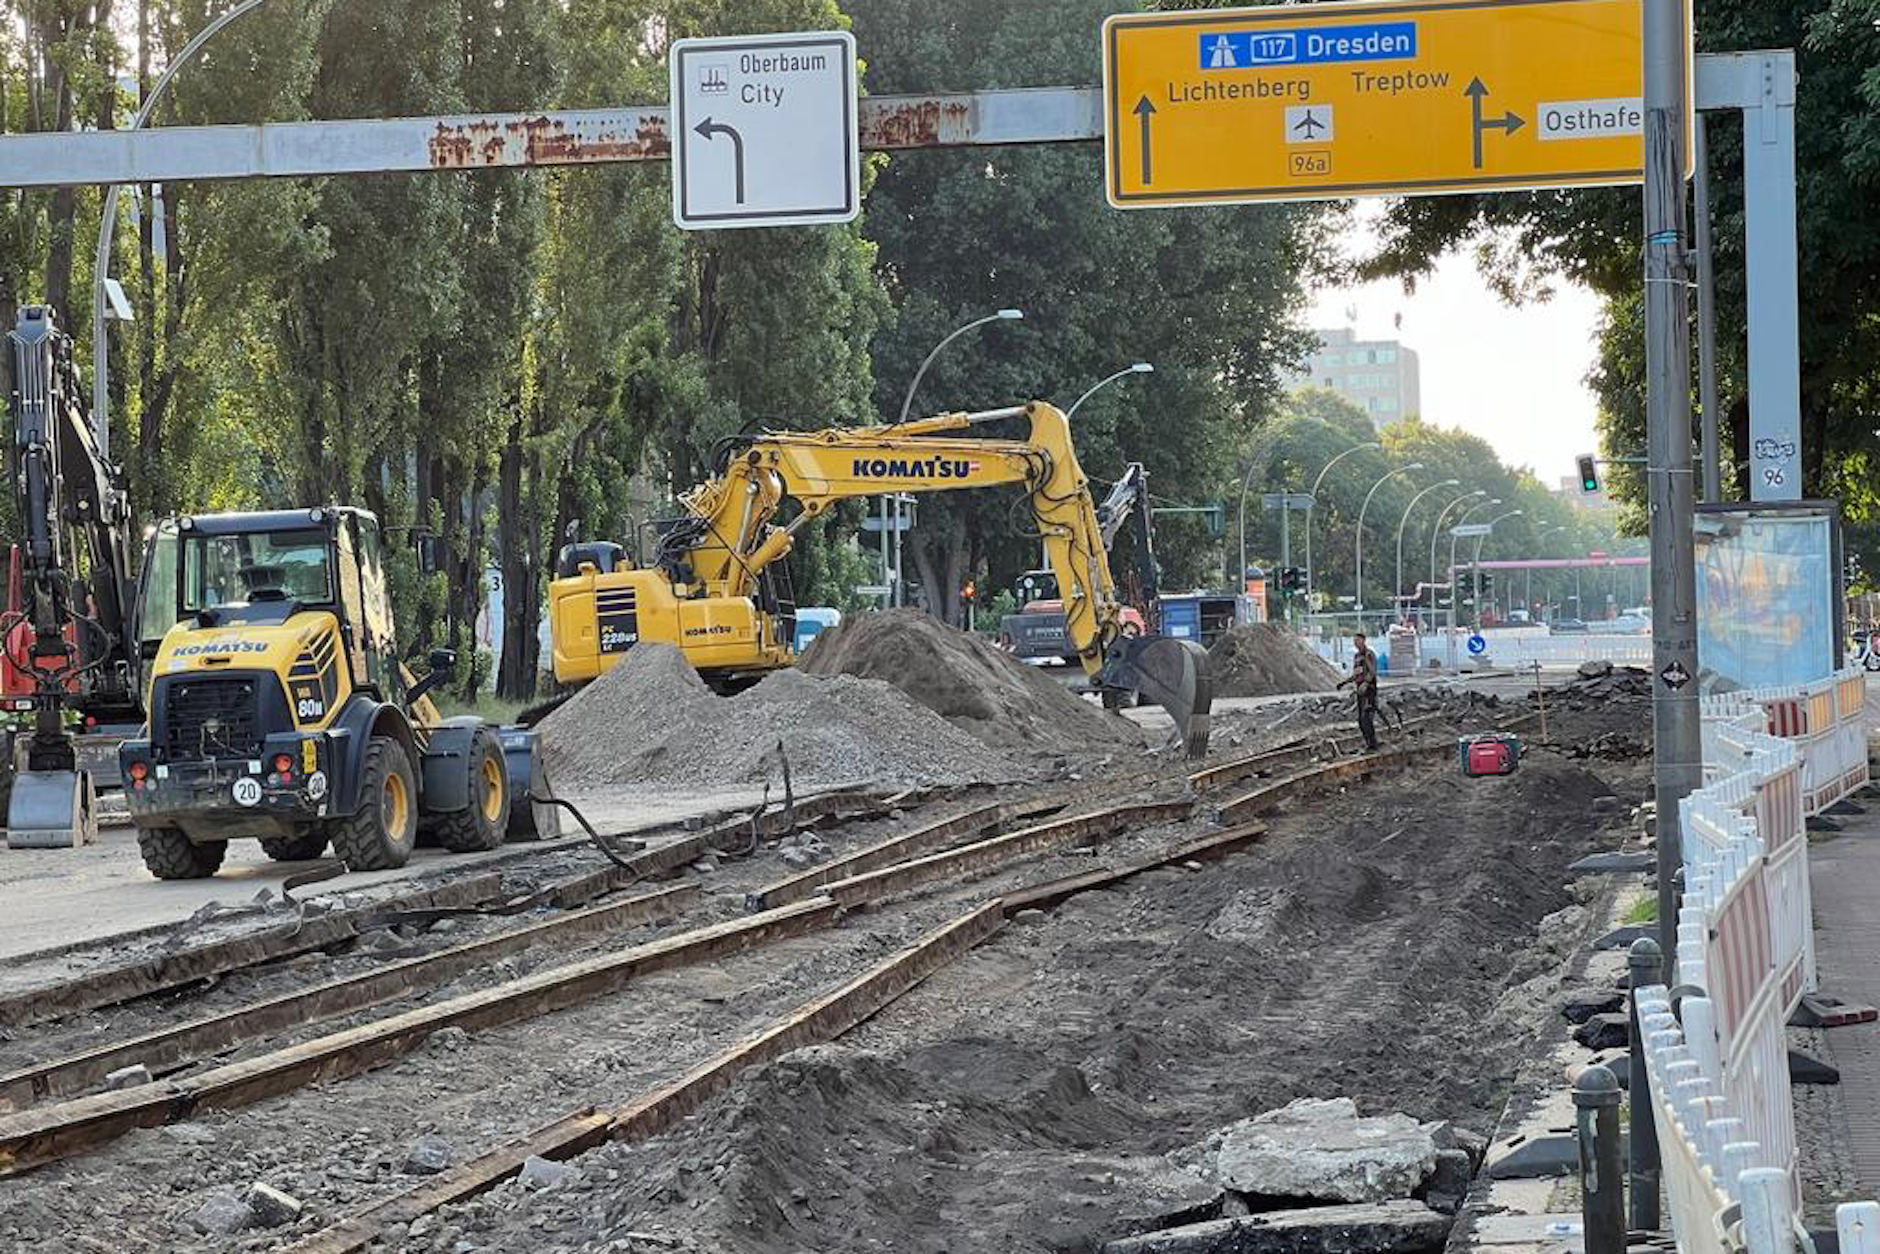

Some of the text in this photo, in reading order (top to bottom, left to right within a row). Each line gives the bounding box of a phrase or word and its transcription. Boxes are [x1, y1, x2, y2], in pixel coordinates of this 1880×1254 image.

[1260, 31, 1410, 57] 117 Dresden
[740, 53, 826, 74] Oberbaum
[1168, 78, 1310, 102] Lichtenberg
[1352, 70, 1449, 95] Treptow
[741, 83, 784, 107] City
[1546, 106, 1641, 131] Osthafe
[1294, 156, 1327, 171] 96a
[853, 455, 969, 478] KOMATSU
[1764, 468, 1784, 485] 96
[173, 642, 269, 656] KOMATSU
[239, 784, 256, 800] 20
